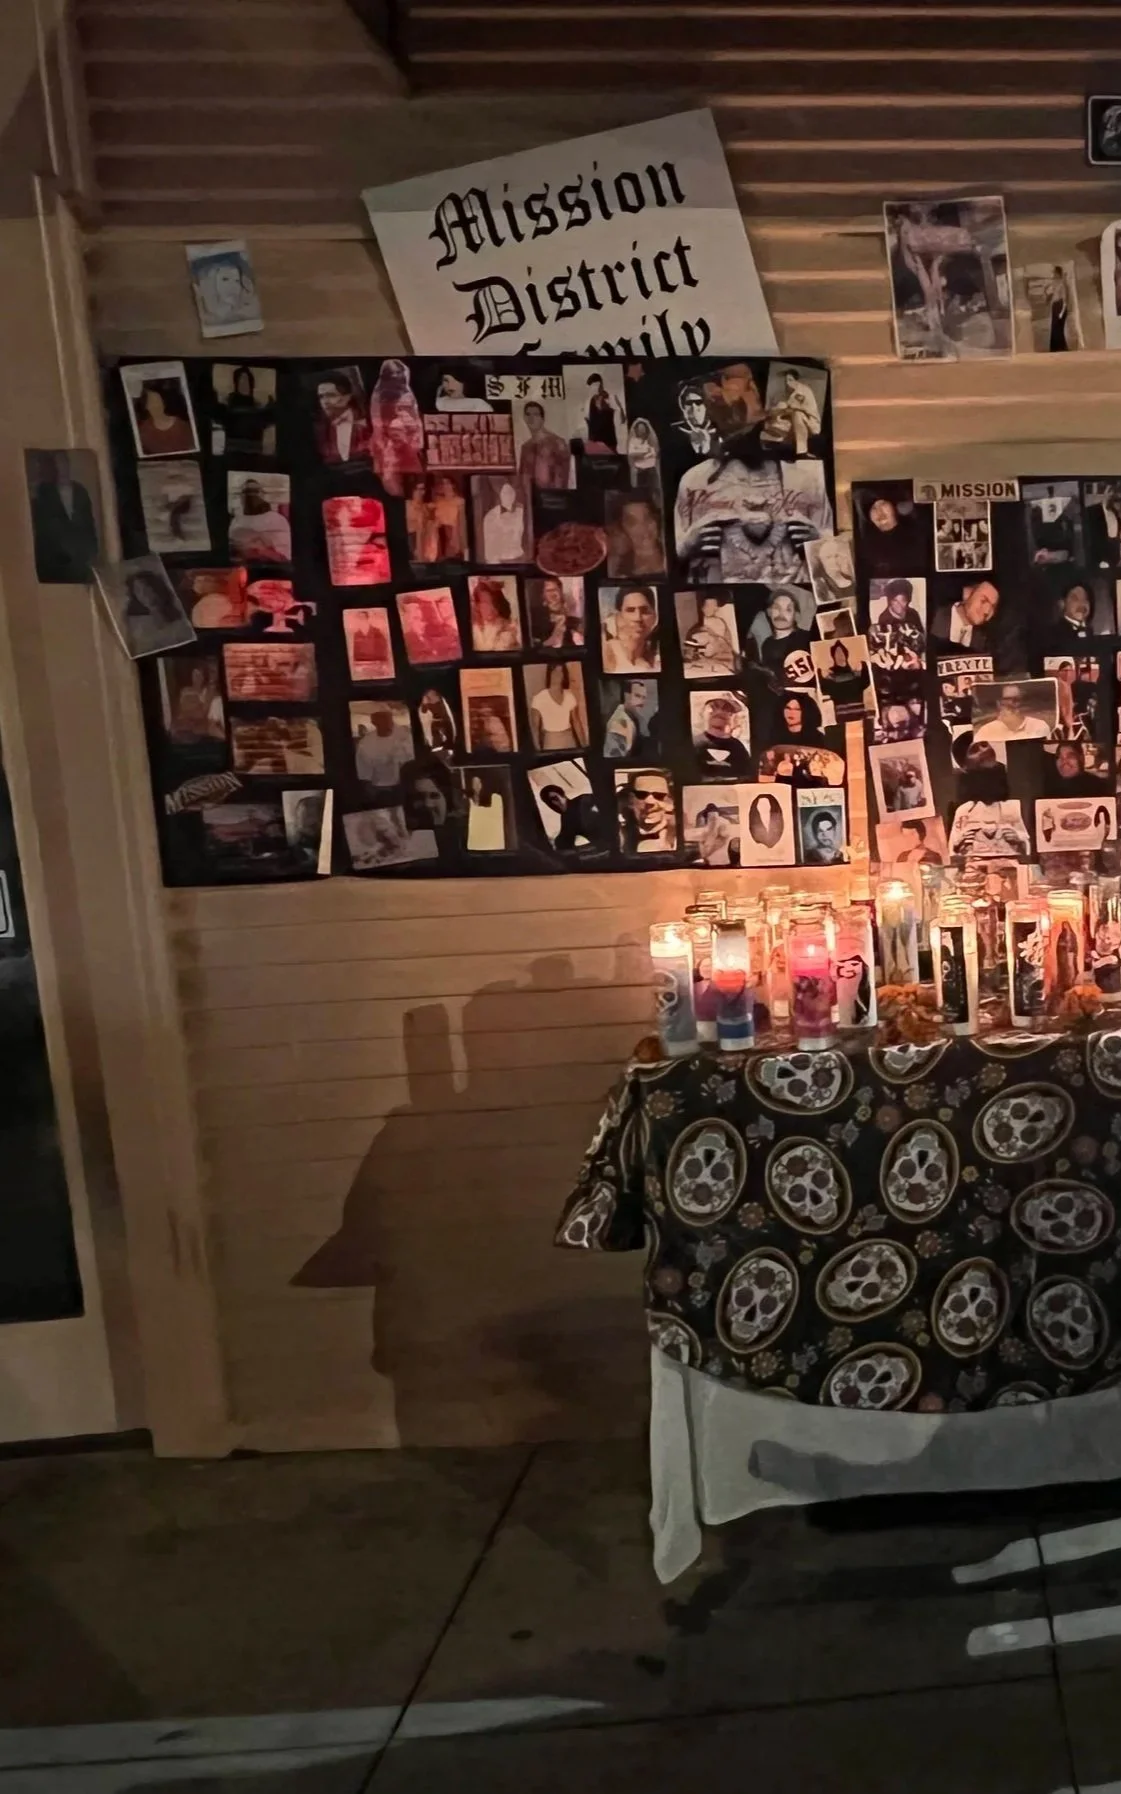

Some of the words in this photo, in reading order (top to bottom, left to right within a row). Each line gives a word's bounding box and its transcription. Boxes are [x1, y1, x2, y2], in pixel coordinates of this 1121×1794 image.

[428, 160, 687, 272] Mission
[451, 235, 701, 345] District
[940, 482, 1016, 498] MISSION
